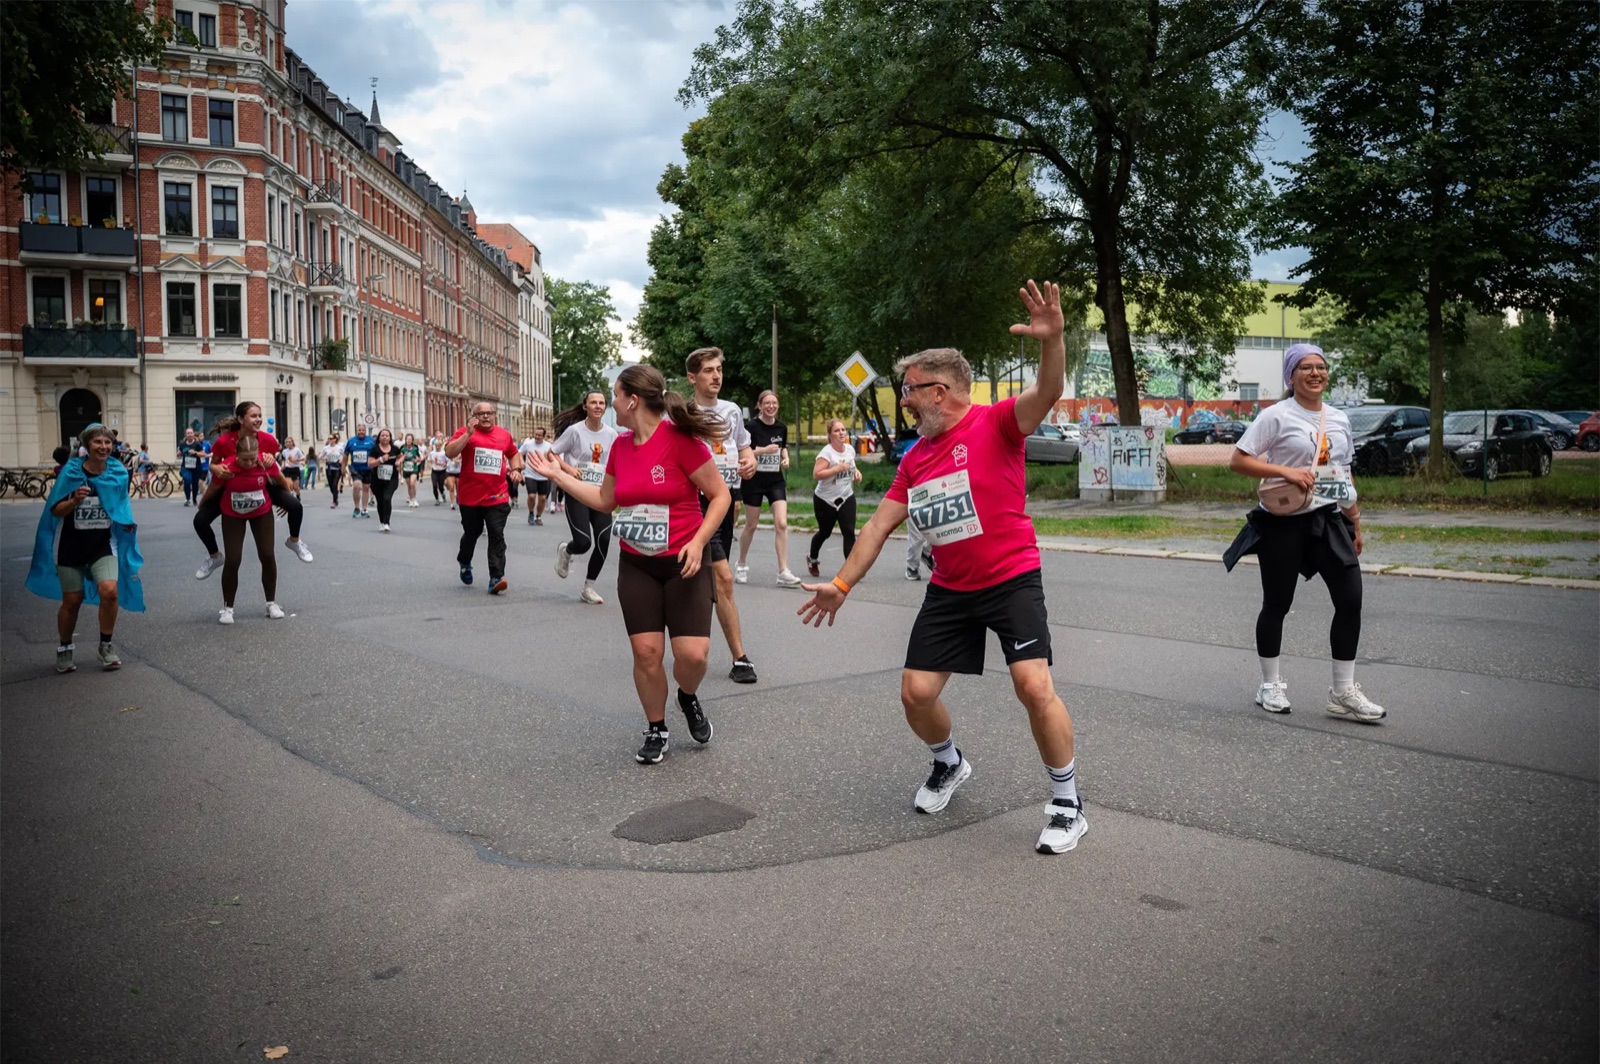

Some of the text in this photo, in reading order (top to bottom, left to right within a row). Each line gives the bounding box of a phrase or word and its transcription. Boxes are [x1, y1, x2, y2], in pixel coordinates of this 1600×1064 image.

[476, 457, 501, 466] 17938
[77, 509, 109, 519] 1736
[912, 496, 973, 529] 17751
[615, 524, 666, 541] 17748
